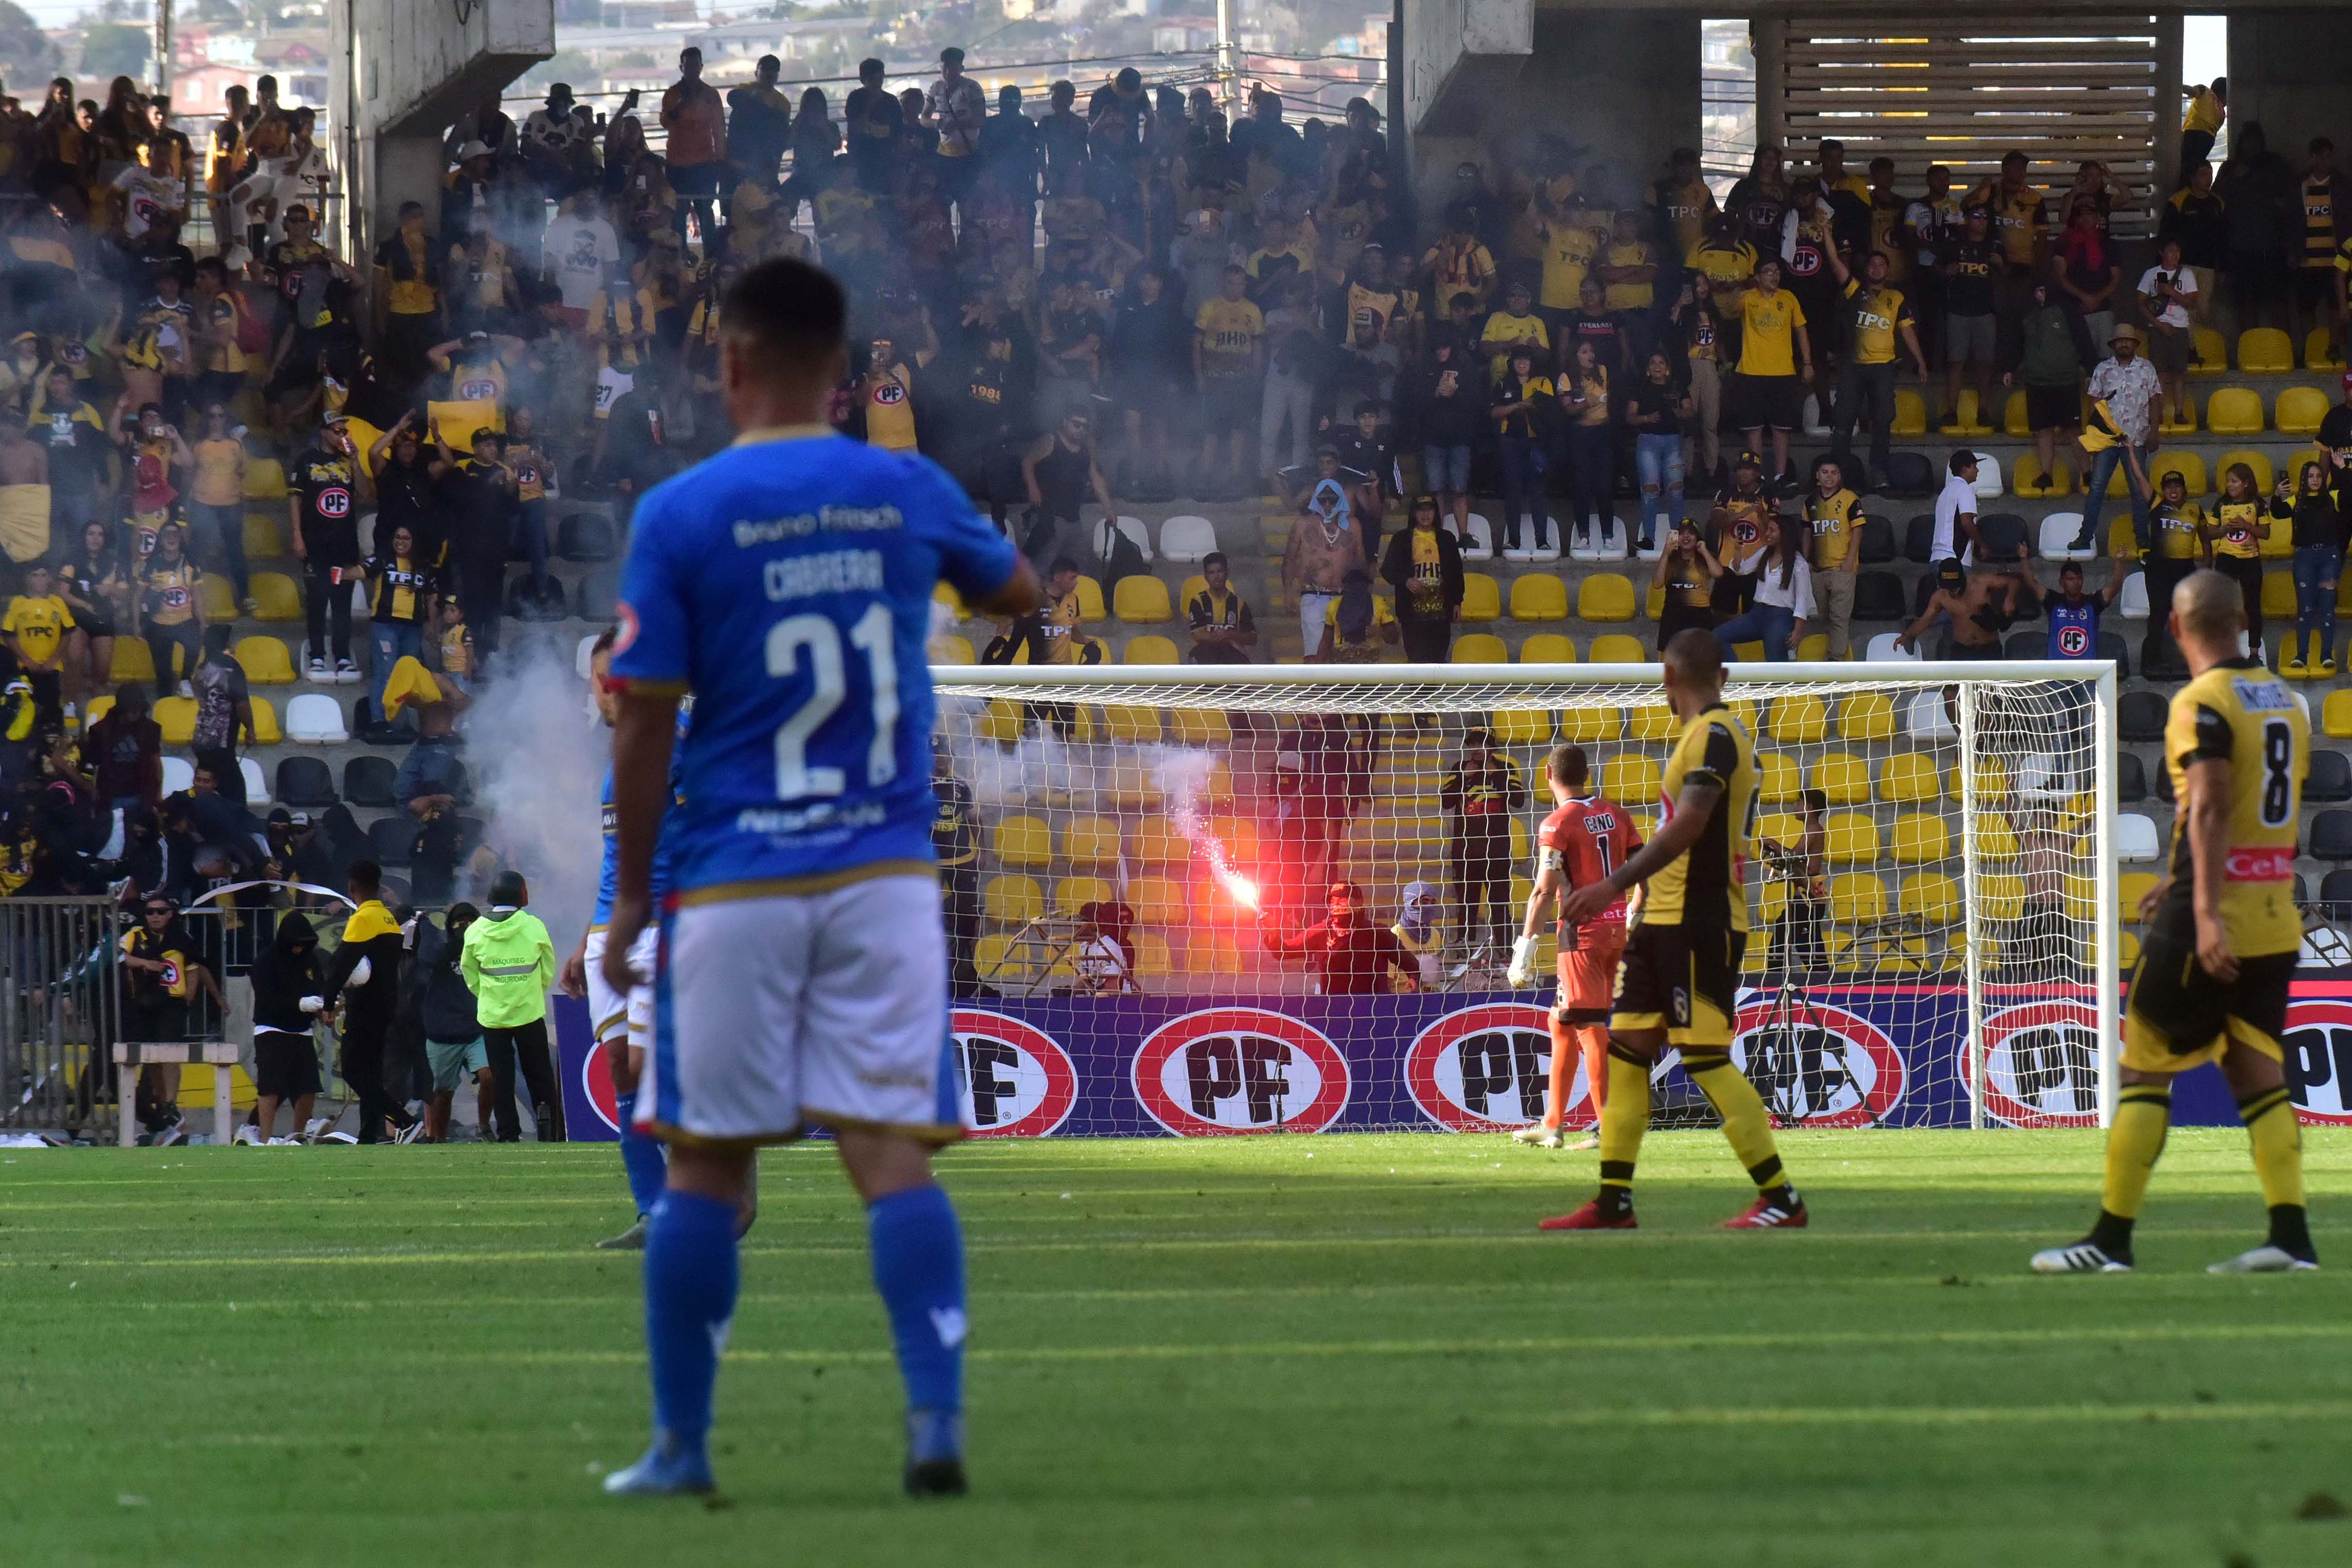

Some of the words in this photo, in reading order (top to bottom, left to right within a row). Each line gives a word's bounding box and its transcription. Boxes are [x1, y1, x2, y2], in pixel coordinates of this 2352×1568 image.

[1667, 205, 1699, 218] TPC
[2306, 206, 2329, 215] TPC
[1793, 252, 1815, 269] PF
[1959, 262, 1989, 275] TPC
[1856, 310, 1891, 330] TPC
[882, 386, 900, 400] PF
[325, 494, 346, 512] PF
[1811, 519, 1840, 534] TPC
[2159, 517, 2195, 533] TPC
[387, 570, 425, 586] TPC
[25, 626, 52, 637] TPC
[2063, 632, 2082, 651] PF
[764, 602, 900, 802] 21
[2261, 718, 2293, 827] 8
[1584, 812, 1615, 833] CANO
[1596, 833, 1613, 880] 1
[492, 957, 526, 966] MAQUISEG
[1457, 1031, 1554, 1119] PF
[1744, 1027, 1849, 1113] PF
[955, 1036, 1020, 1127] F
[1186, 1036, 1293, 1124] PF
